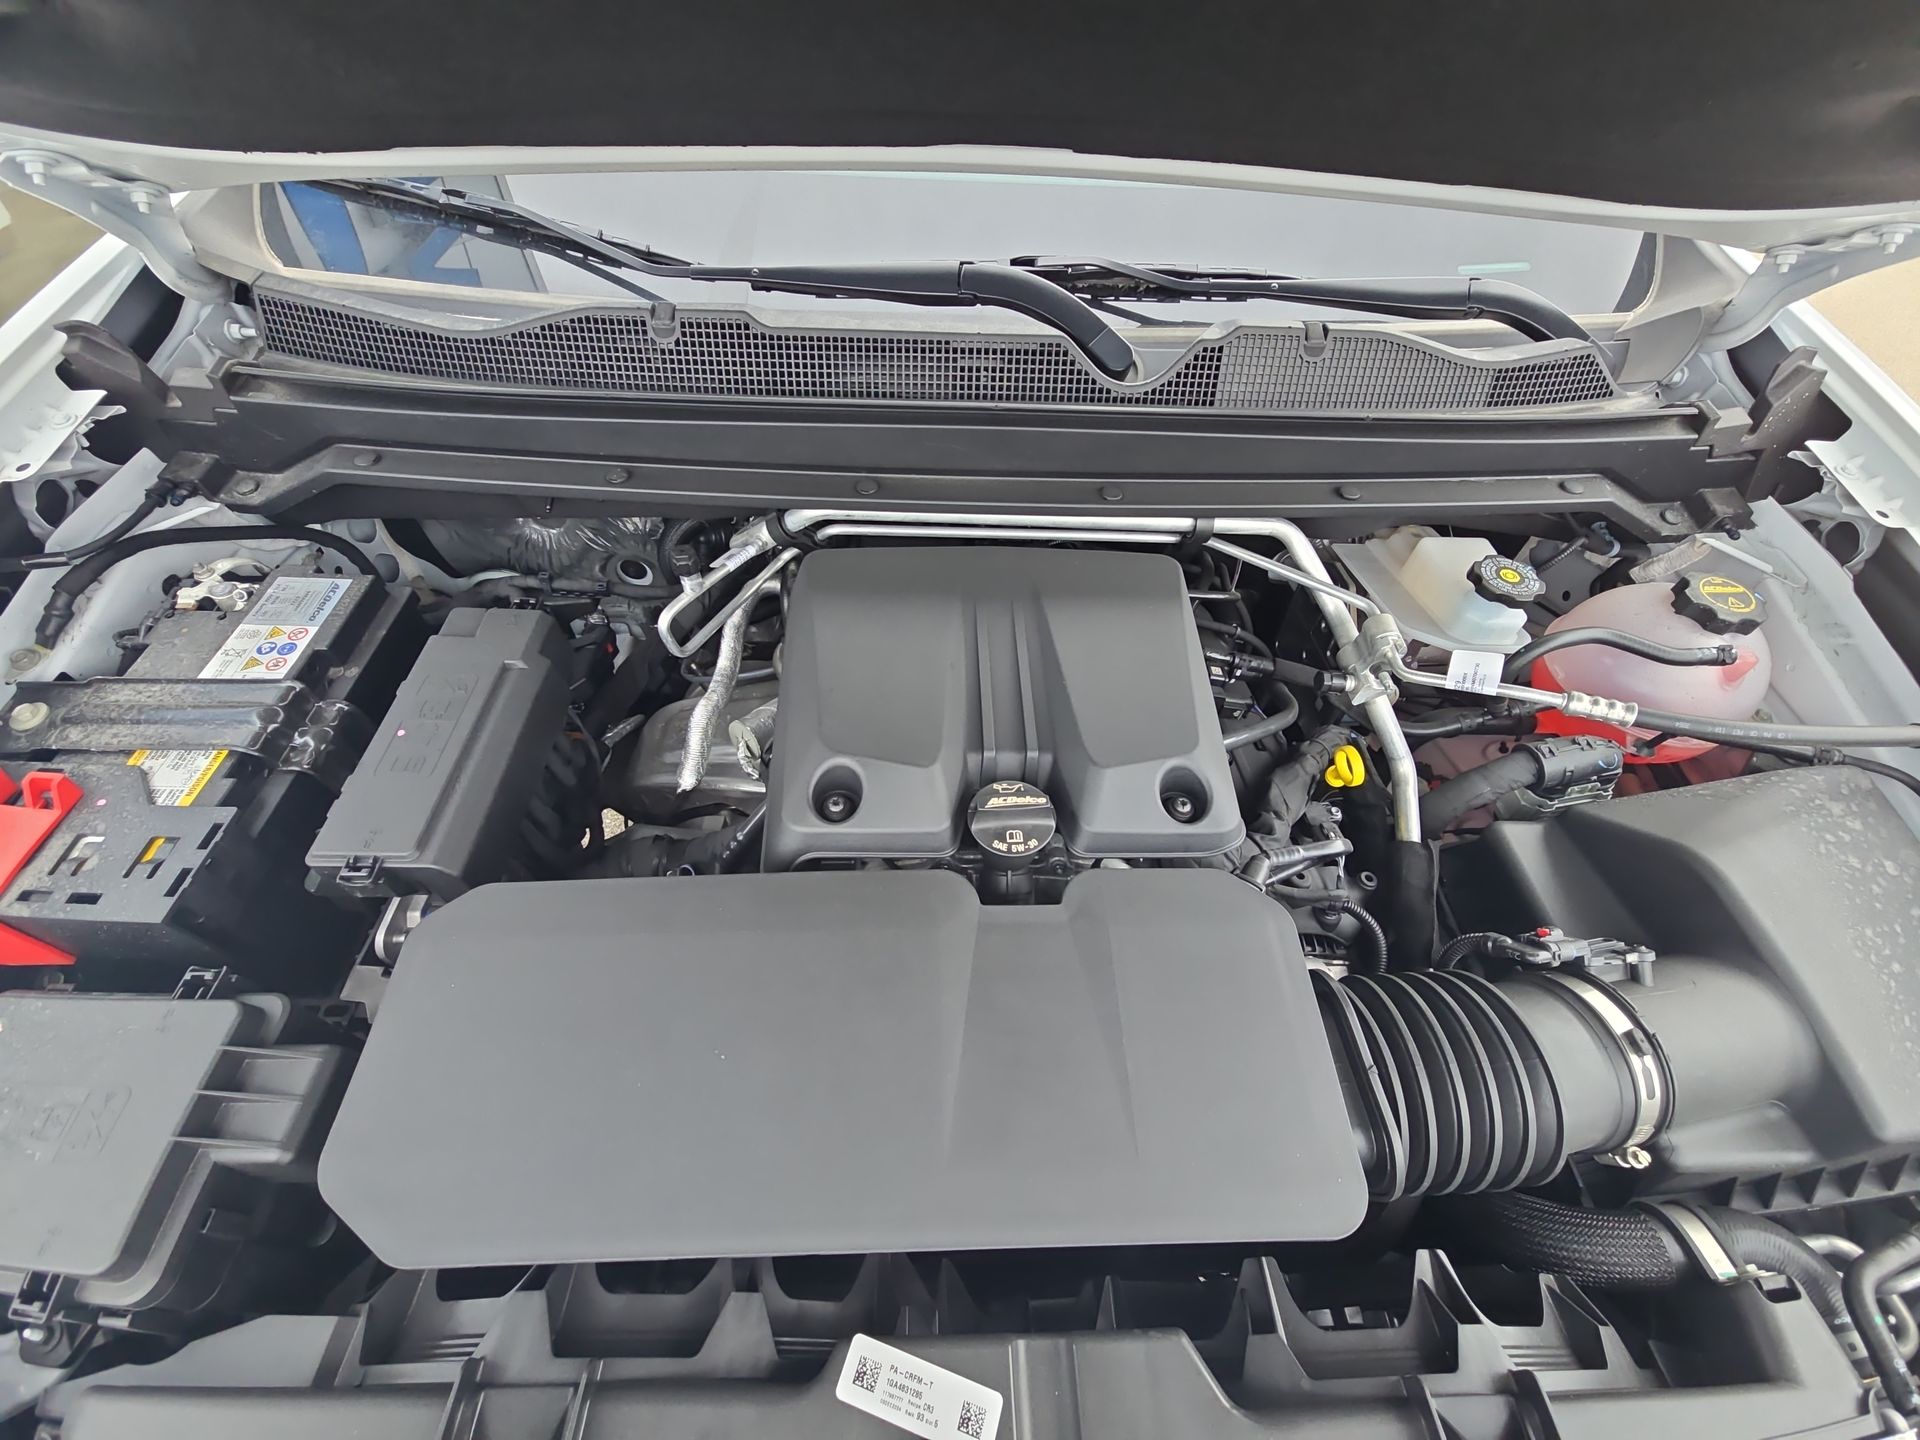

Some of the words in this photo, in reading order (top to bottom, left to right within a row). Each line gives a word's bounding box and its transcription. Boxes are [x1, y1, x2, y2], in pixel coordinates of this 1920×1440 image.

[309, 583, 340, 622] ACDelco
[985, 796, 1047, 808] ACDelco
[992, 839, 1008, 852] SAE
[1011, 838, 1039, 853] 5W-30
